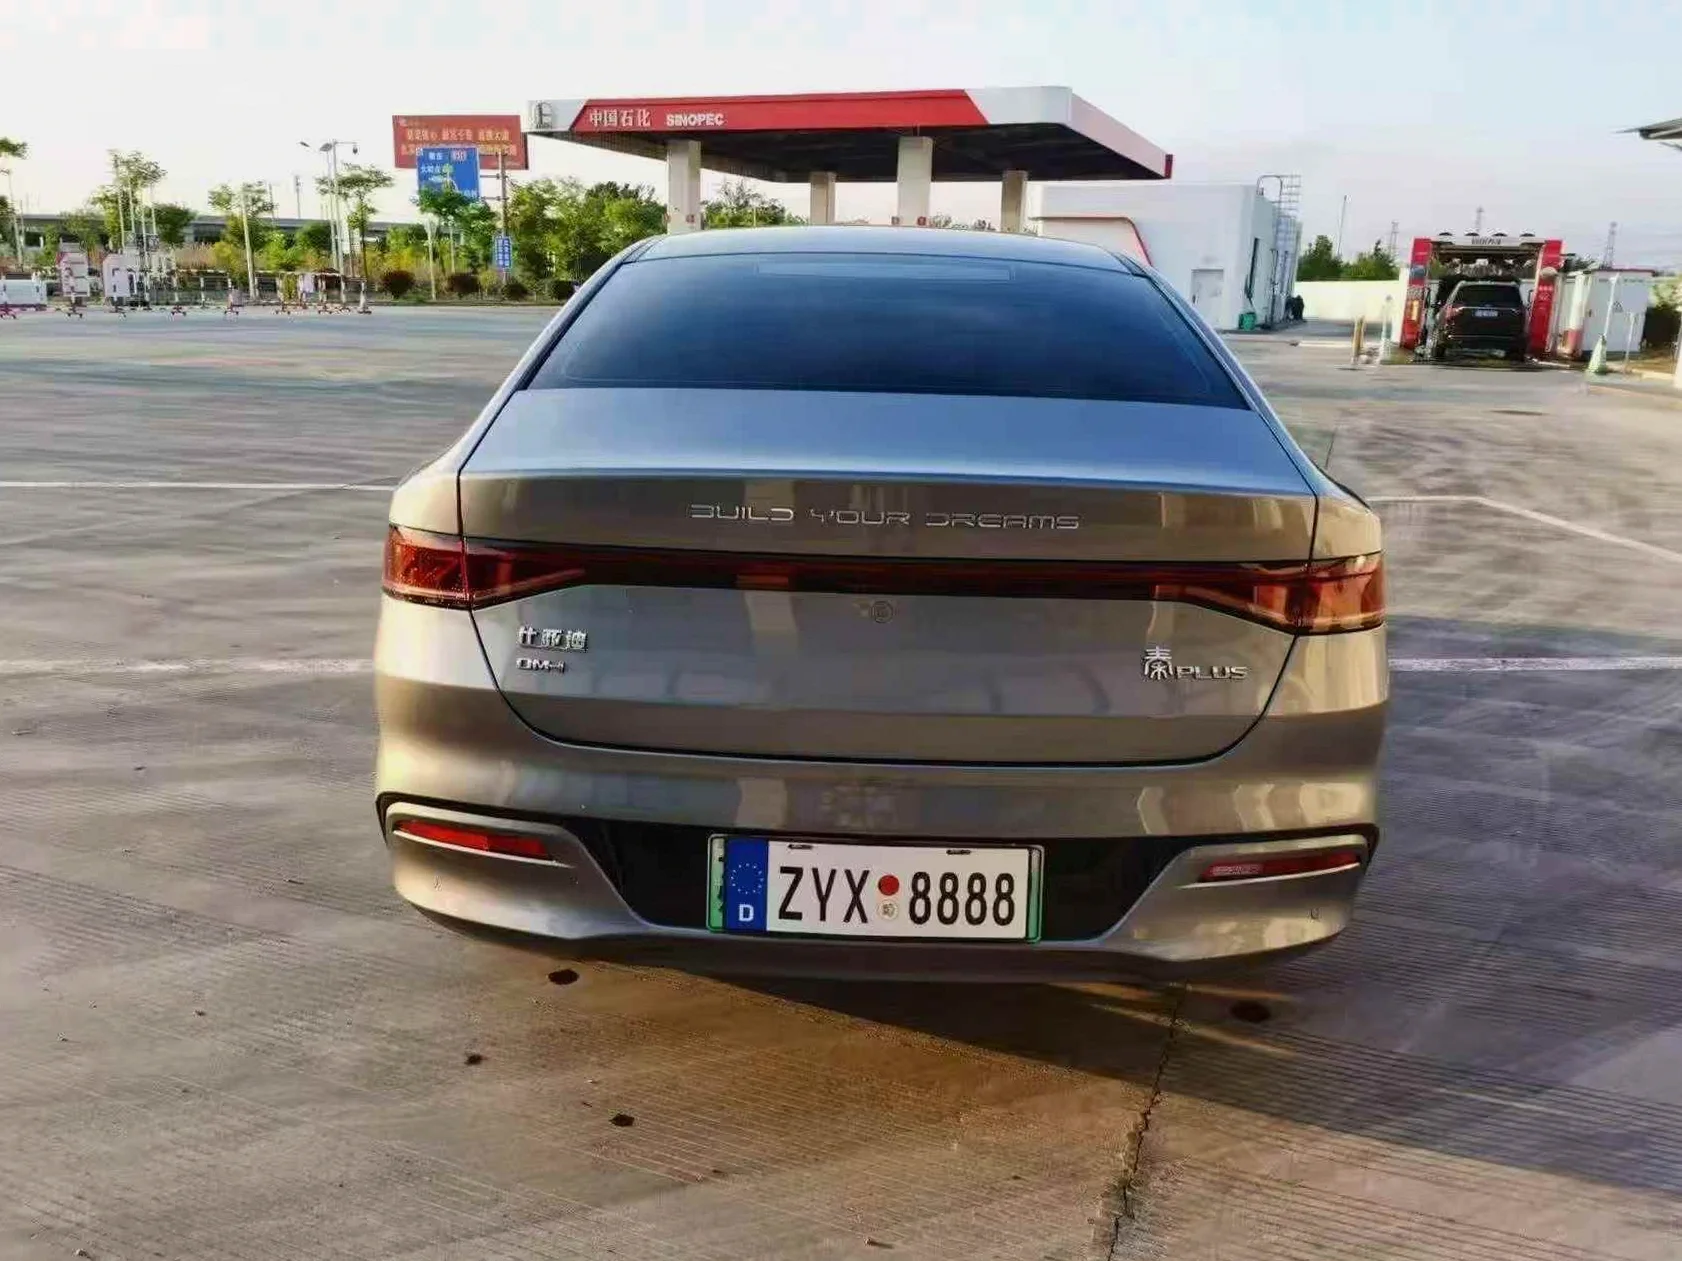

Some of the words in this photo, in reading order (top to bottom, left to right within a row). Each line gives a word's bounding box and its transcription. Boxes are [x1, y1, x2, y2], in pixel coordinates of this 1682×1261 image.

[589, 108, 650, 127] 中国石化
[666, 112, 725, 127] SINOPEC
[691, 504, 794, 522] BUILD
[925, 511, 1080, 530] DREAMS
[777, 865, 871, 924] ZYX
[908, 871, 1016, 926] 8888
[738, 903, 754, 922] D
